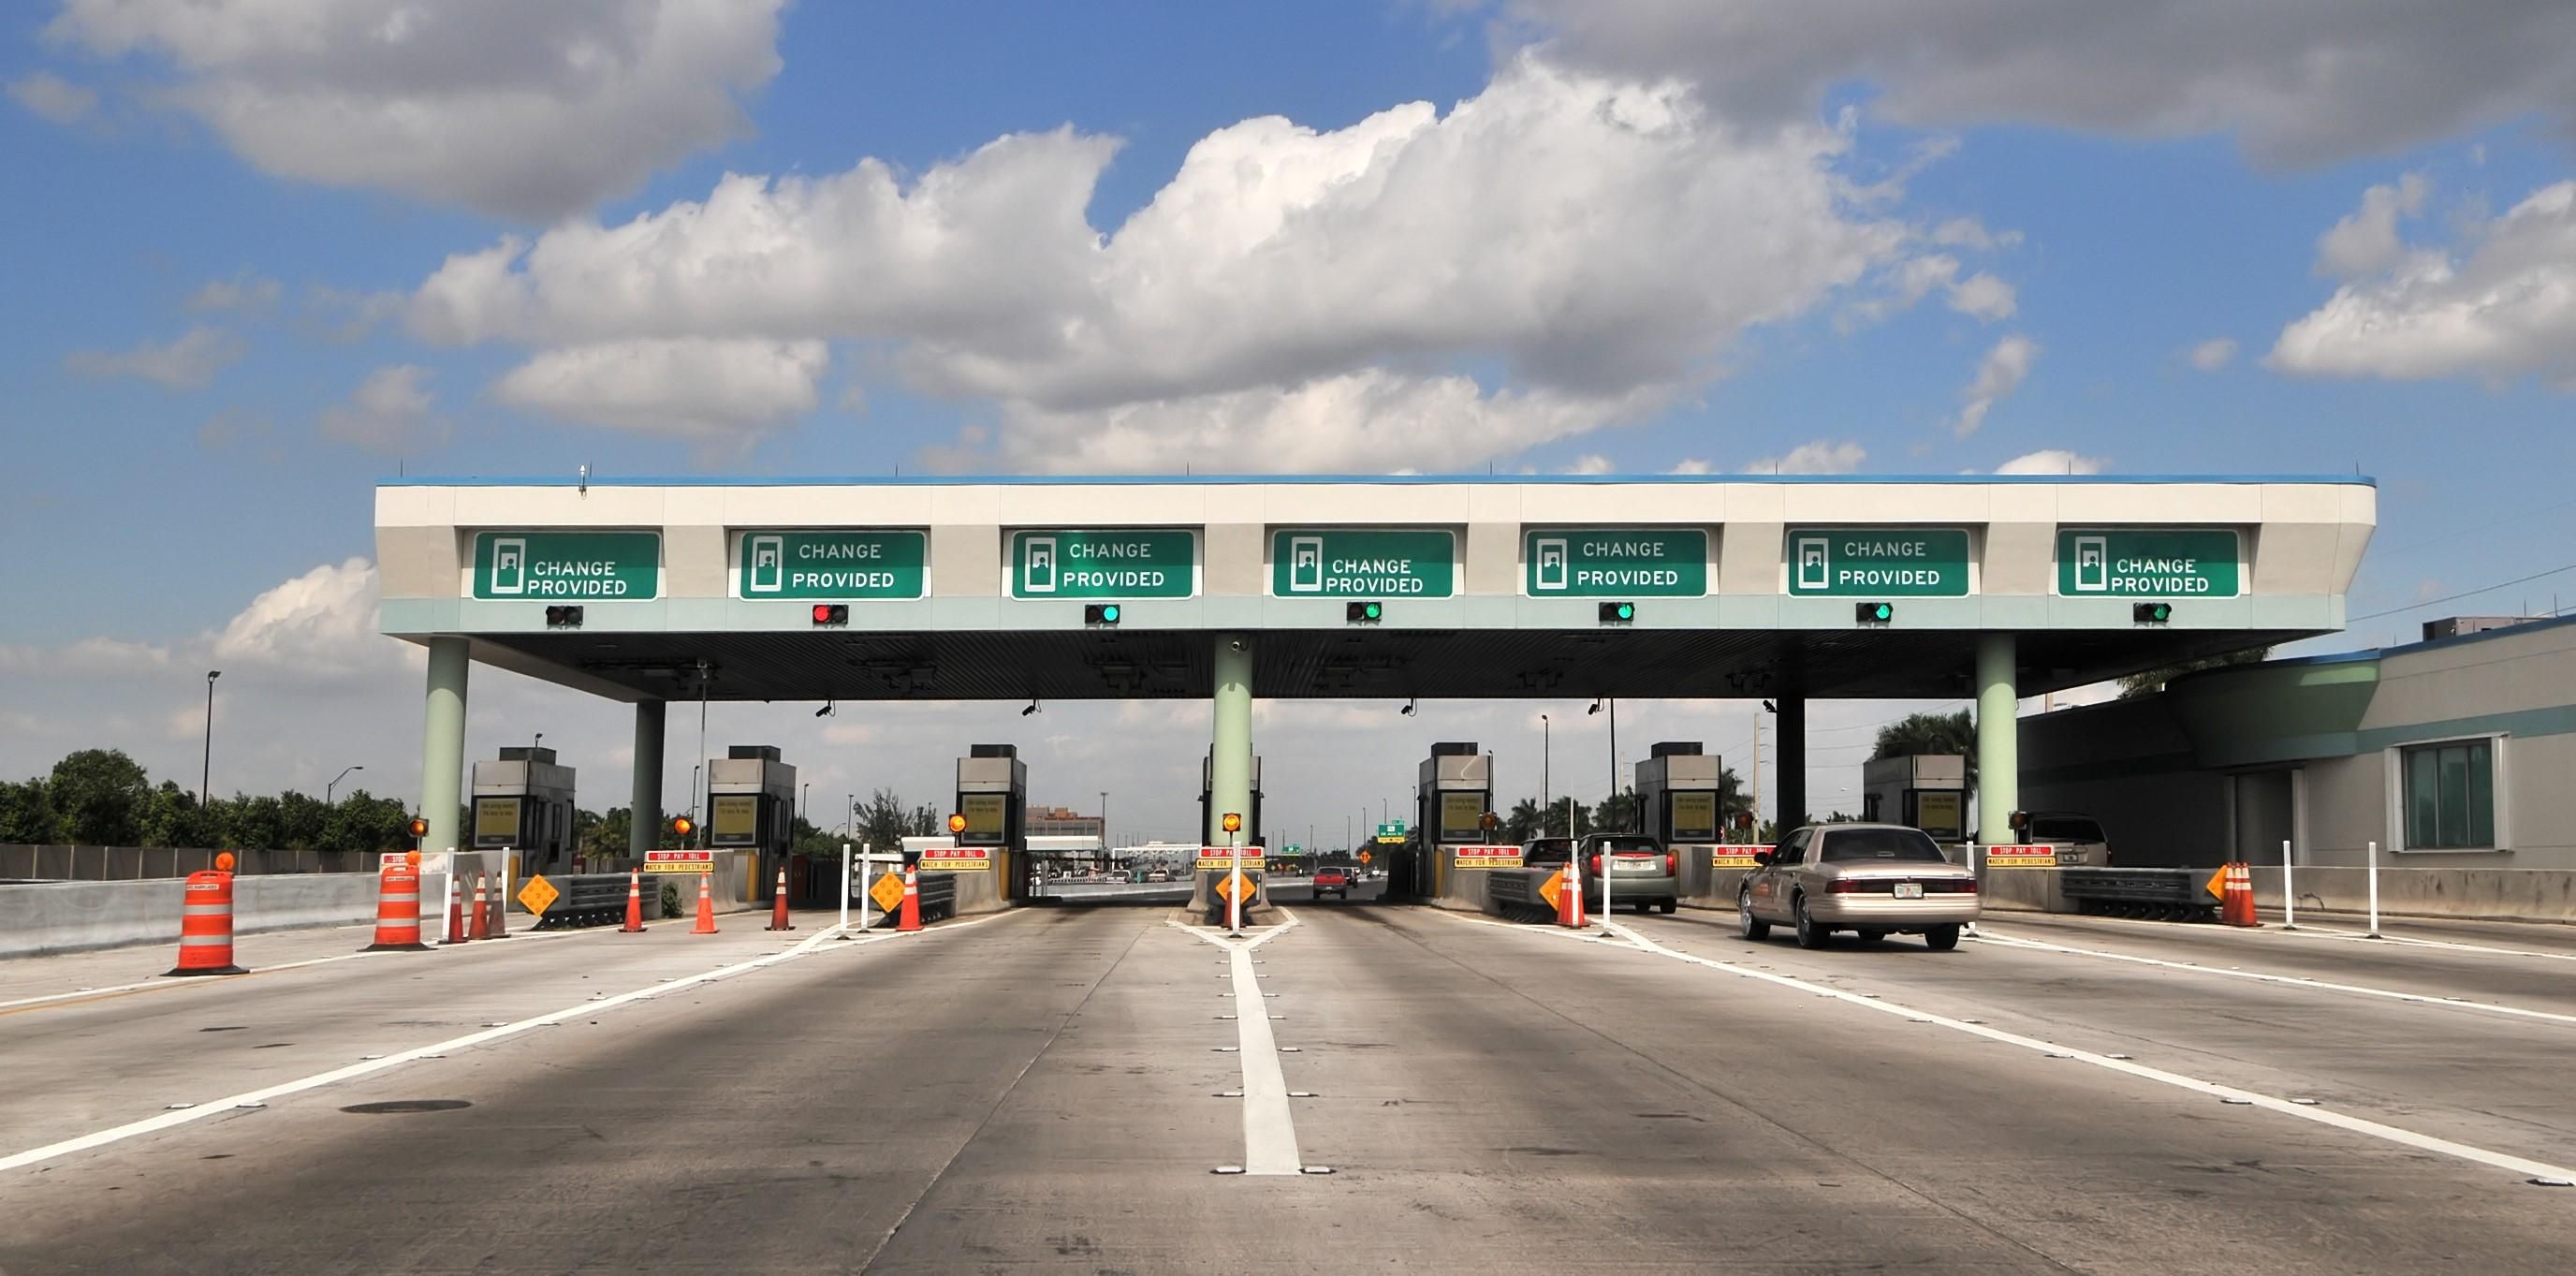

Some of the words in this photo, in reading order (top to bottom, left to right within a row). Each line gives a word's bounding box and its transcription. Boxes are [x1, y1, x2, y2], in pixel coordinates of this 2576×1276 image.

[799, 545, 881, 558] CHANGE
[1070, 544, 1150, 558] CHANGE
[1584, 542, 1663, 556] CHANGE
[1845, 542, 1925, 556] CHANGE
[534, 562, 615, 576] CHANGE
[1333, 559, 1411, 574] CHANGE
[2117, 559, 2196, 573] CHANGE
[793, 573, 894, 587] PROVIDED
[1064, 572, 1164, 586] PROVIDED
[1578, 571, 1677, 585] PROVIDED
[1840, 570, 1939, 584] PROVIDED
[528, 579, 626, 594] PROVIDED
[1326, 578, 1423, 593] PROVIDED
[2112, 578, 2208, 592] PROVIDED
